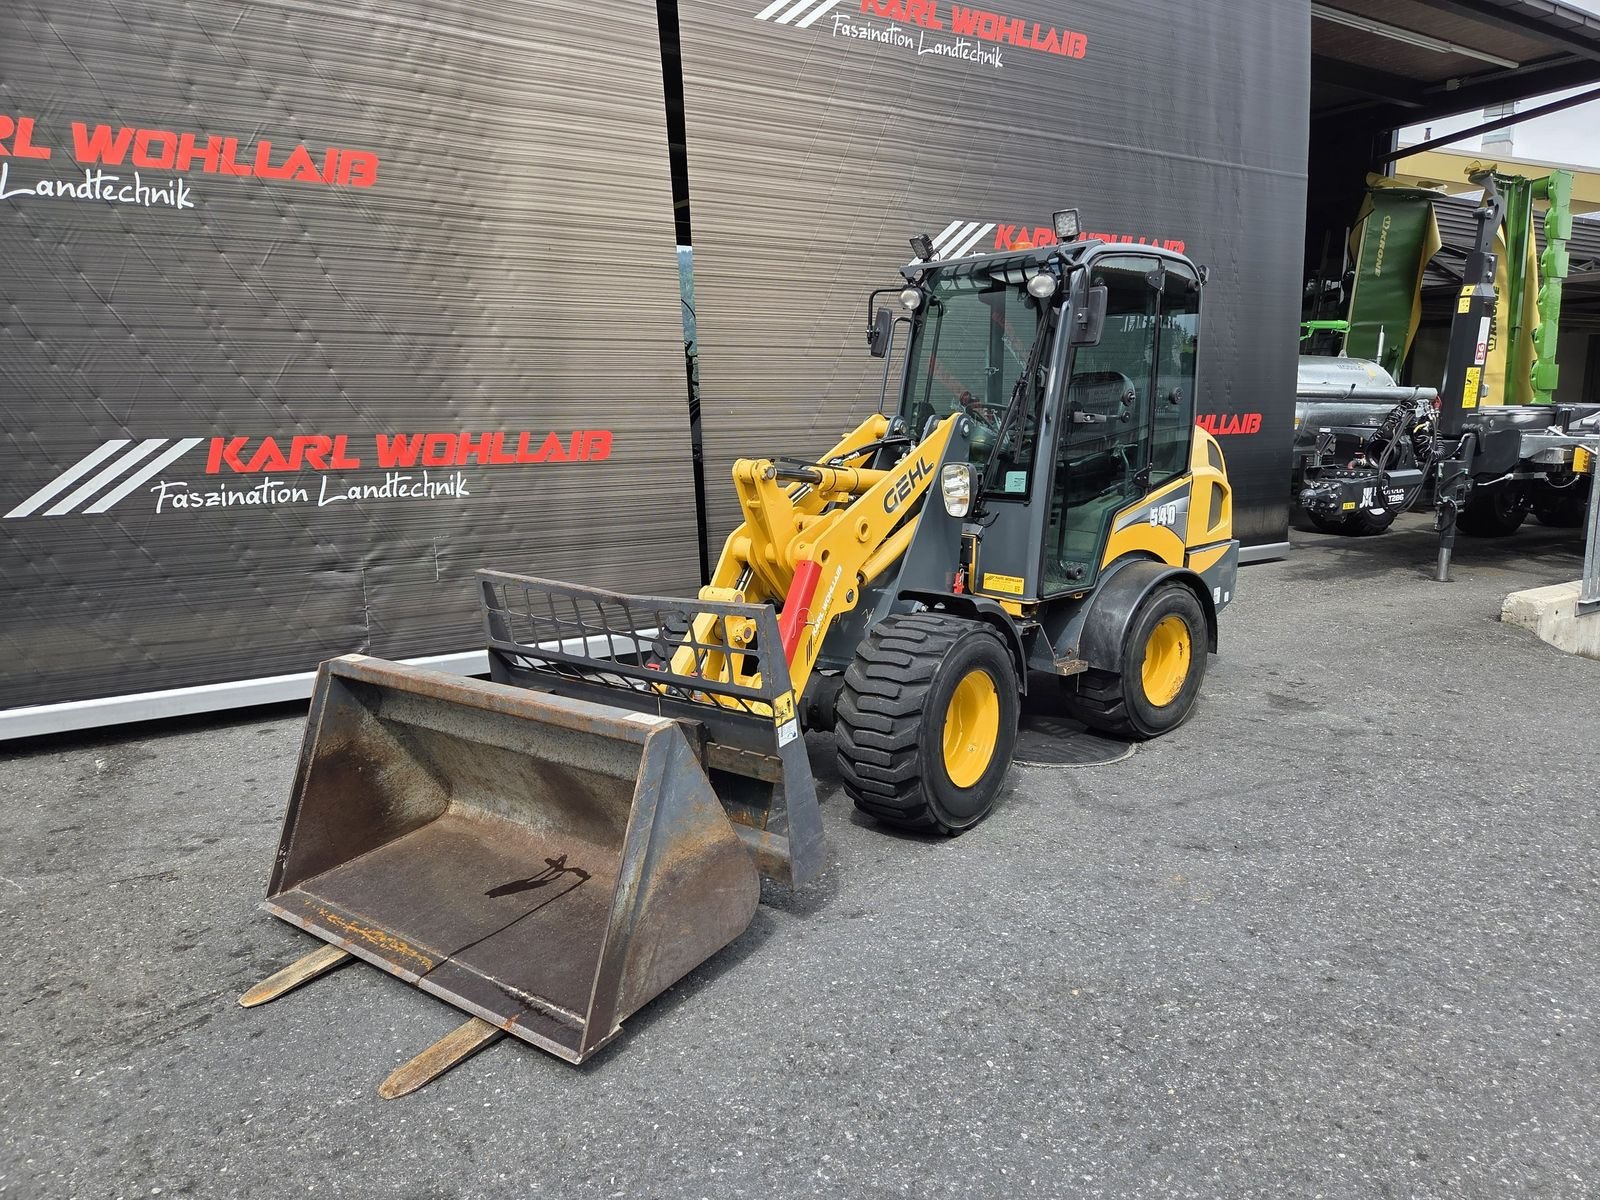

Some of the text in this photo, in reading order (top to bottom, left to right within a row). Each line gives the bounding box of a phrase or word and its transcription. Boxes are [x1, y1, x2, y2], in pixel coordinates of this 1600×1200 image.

[830, 12, 1004, 69] Faszination Landtechnik
[0, 162, 195, 210] Landtechnik
[1375, 229, 1387, 277] KRONE
[205, 434, 361, 474] KARL
[150, 470, 470, 513] Faszination Landtechnik
[883, 455, 935, 514] GEHL
[1150, 504, 1176, 528] 540
